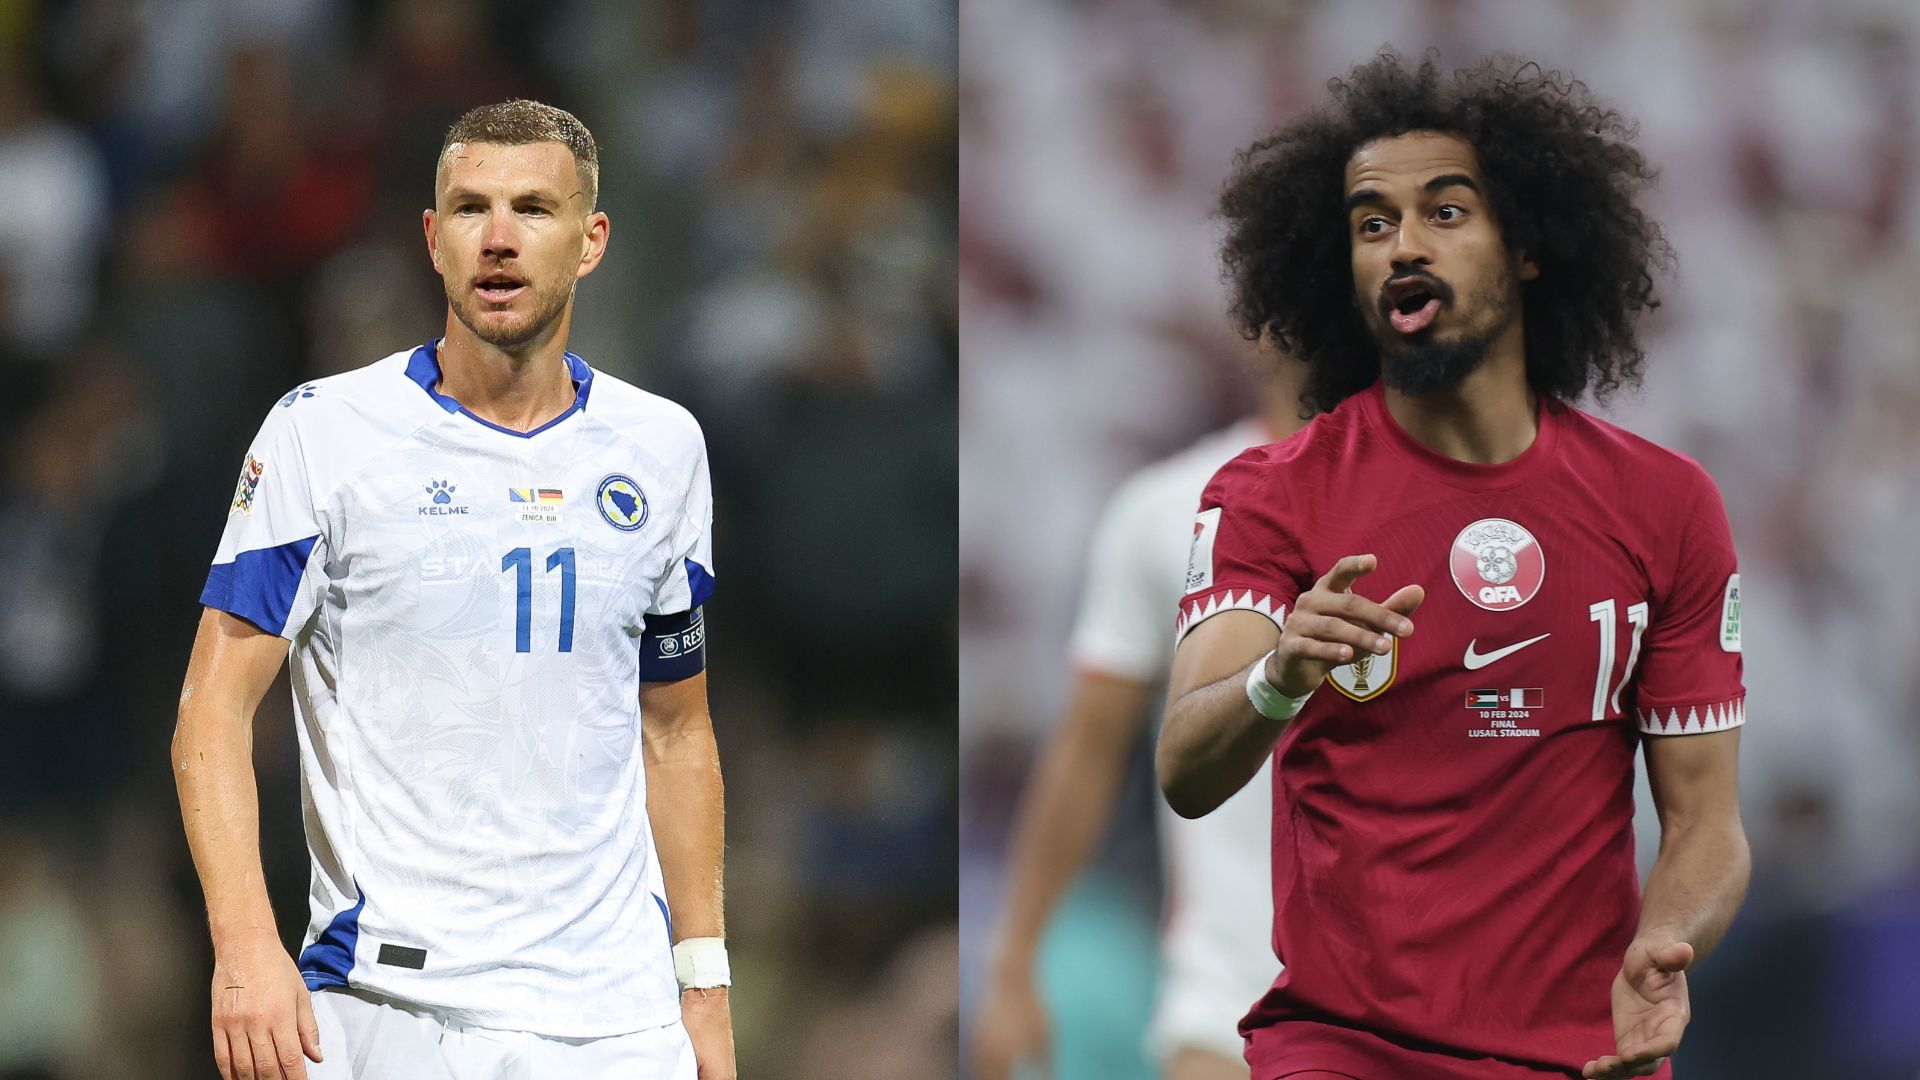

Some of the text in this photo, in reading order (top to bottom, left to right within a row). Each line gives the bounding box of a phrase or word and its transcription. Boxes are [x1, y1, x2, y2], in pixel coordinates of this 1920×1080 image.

[418, 506, 469, 515] KELME
[502, 547, 576, 653] 11
[1479, 585, 1522, 604] QFA
[1590, 598, 1649, 721] 11
[1491, 720, 1517, 728] FINAL
[1468, 729, 1540, 737] LUSAIL STADIUM
